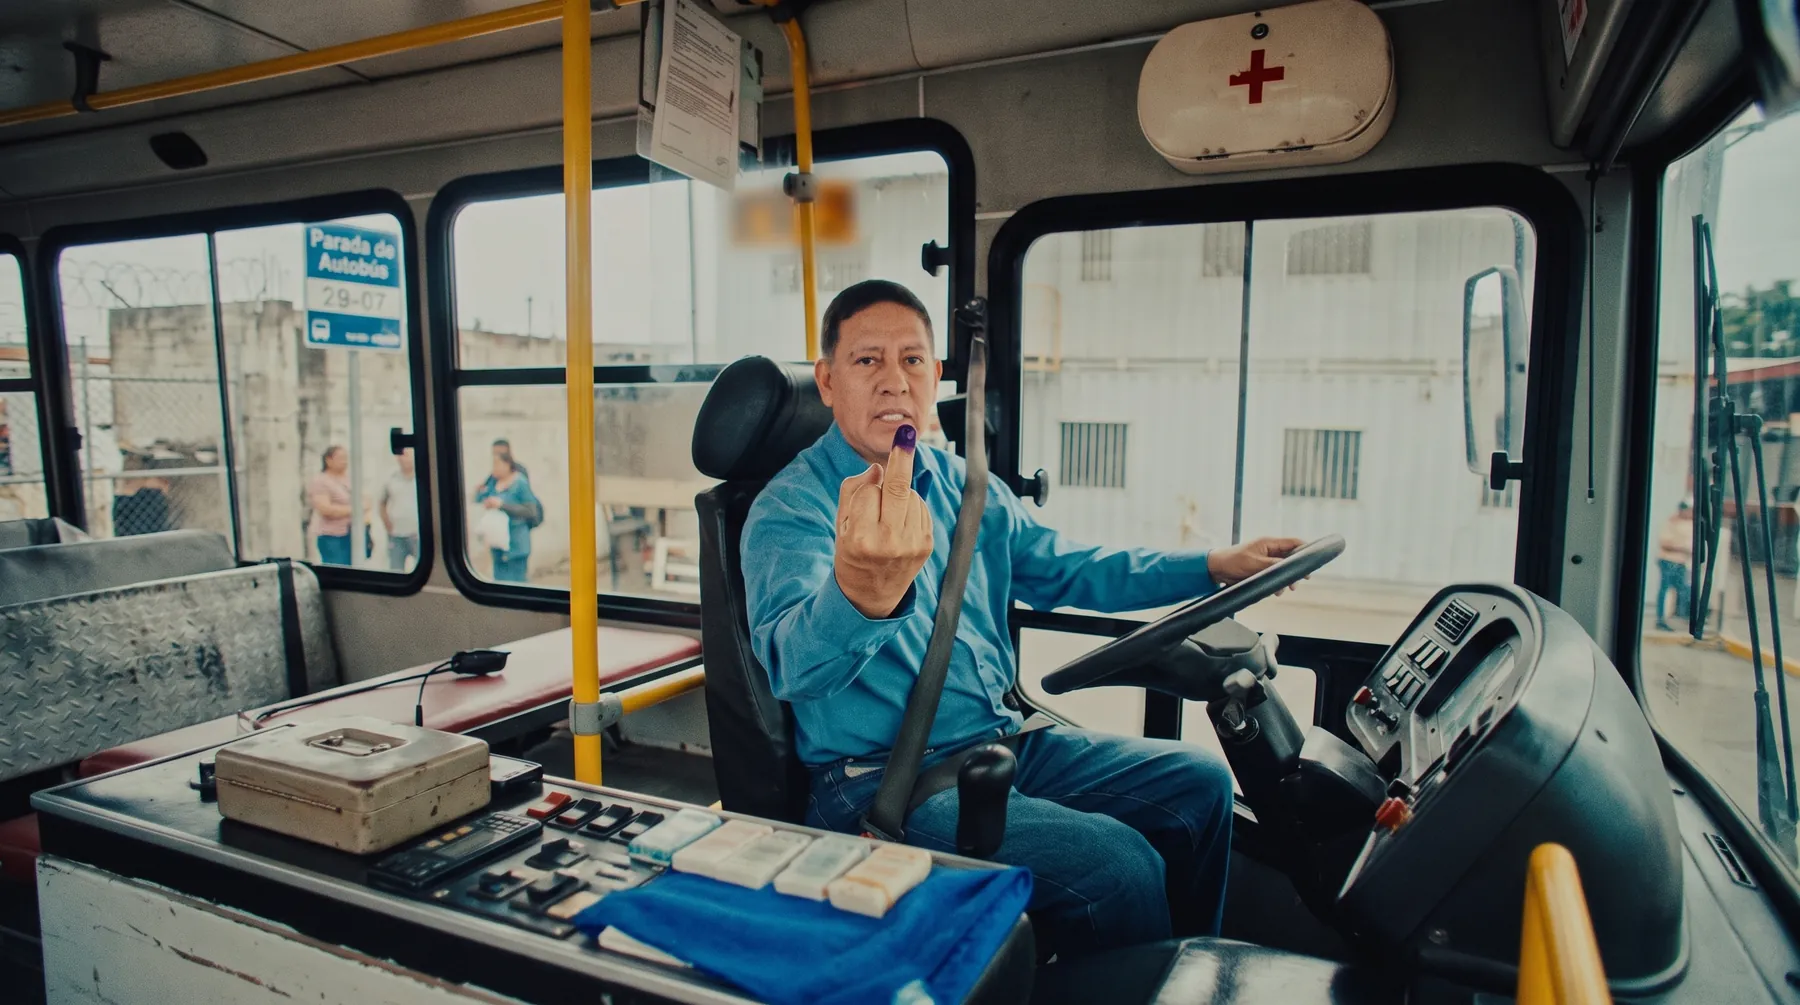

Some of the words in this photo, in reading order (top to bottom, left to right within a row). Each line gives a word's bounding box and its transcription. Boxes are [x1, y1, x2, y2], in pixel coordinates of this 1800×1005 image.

[310, 228, 371, 255] Parada
[374, 240, 395, 259] de
[318, 252, 389, 280] Autobús
[322, 286, 387, 311] 29-07
